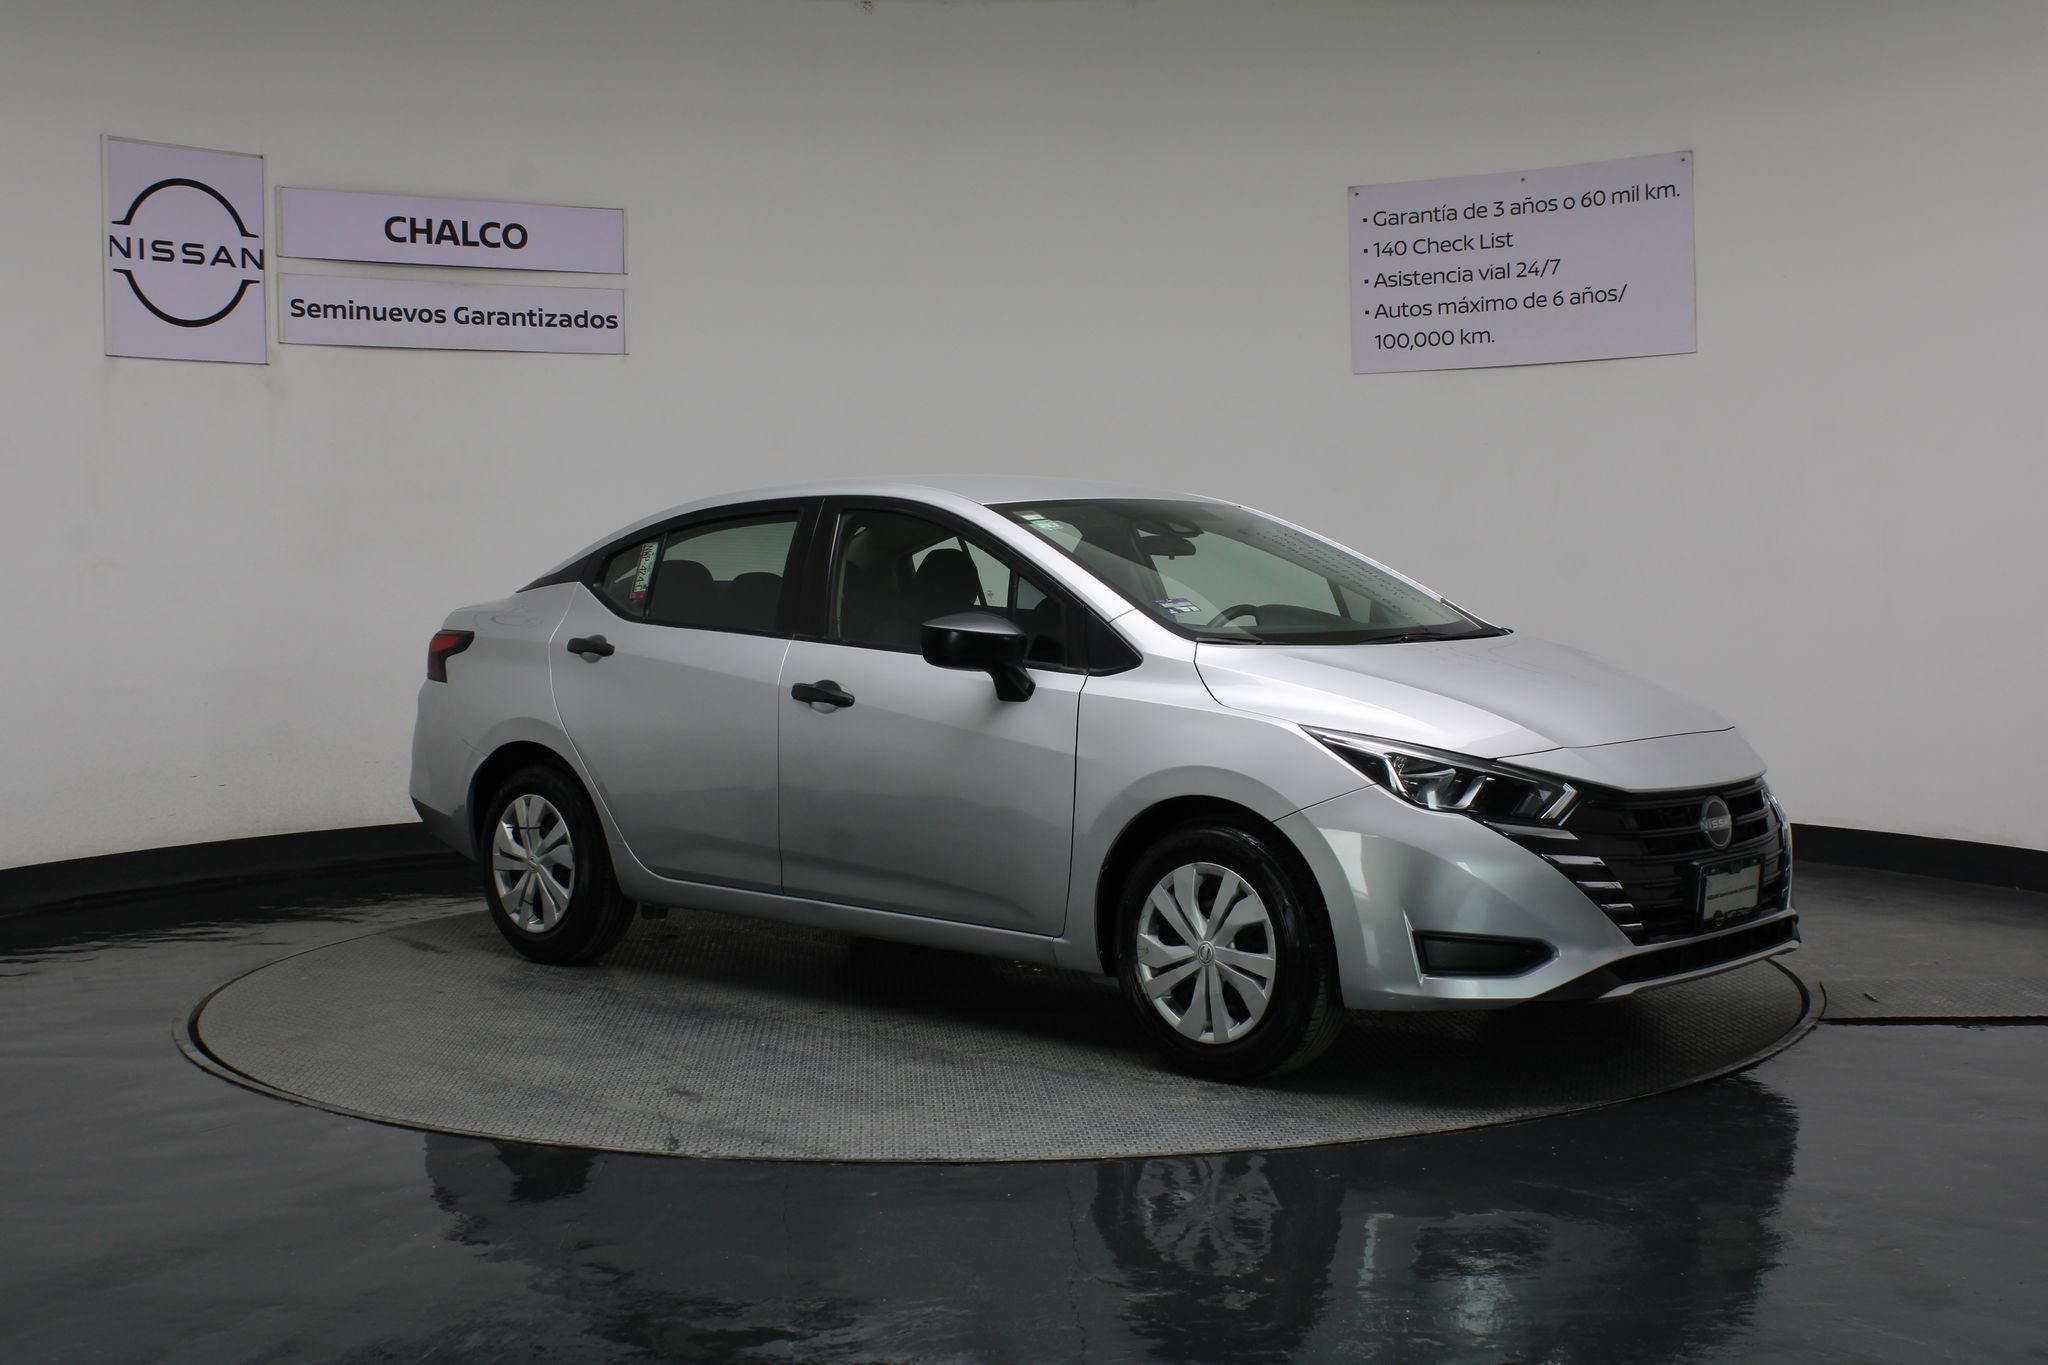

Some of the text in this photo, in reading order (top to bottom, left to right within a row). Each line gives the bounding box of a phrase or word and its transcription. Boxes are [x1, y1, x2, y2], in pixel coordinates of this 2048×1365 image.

[1372, 183, 1681, 227] Garantía de 3 años o 60 mil km.
[384, 215, 529, 250] CHALCO
[1373, 231, 1515, 258] 140 Check List
[108, 234, 265, 270] NISSAN
[1373, 258, 1561, 289] Asistencia vial 24/7
[289, 298, 619, 330] Seminuevos Garantizados
[1373, 283, 1628, 320] Autos máximo de 6 años/
[1374, 328, 1496, 351] 100,000 km.
